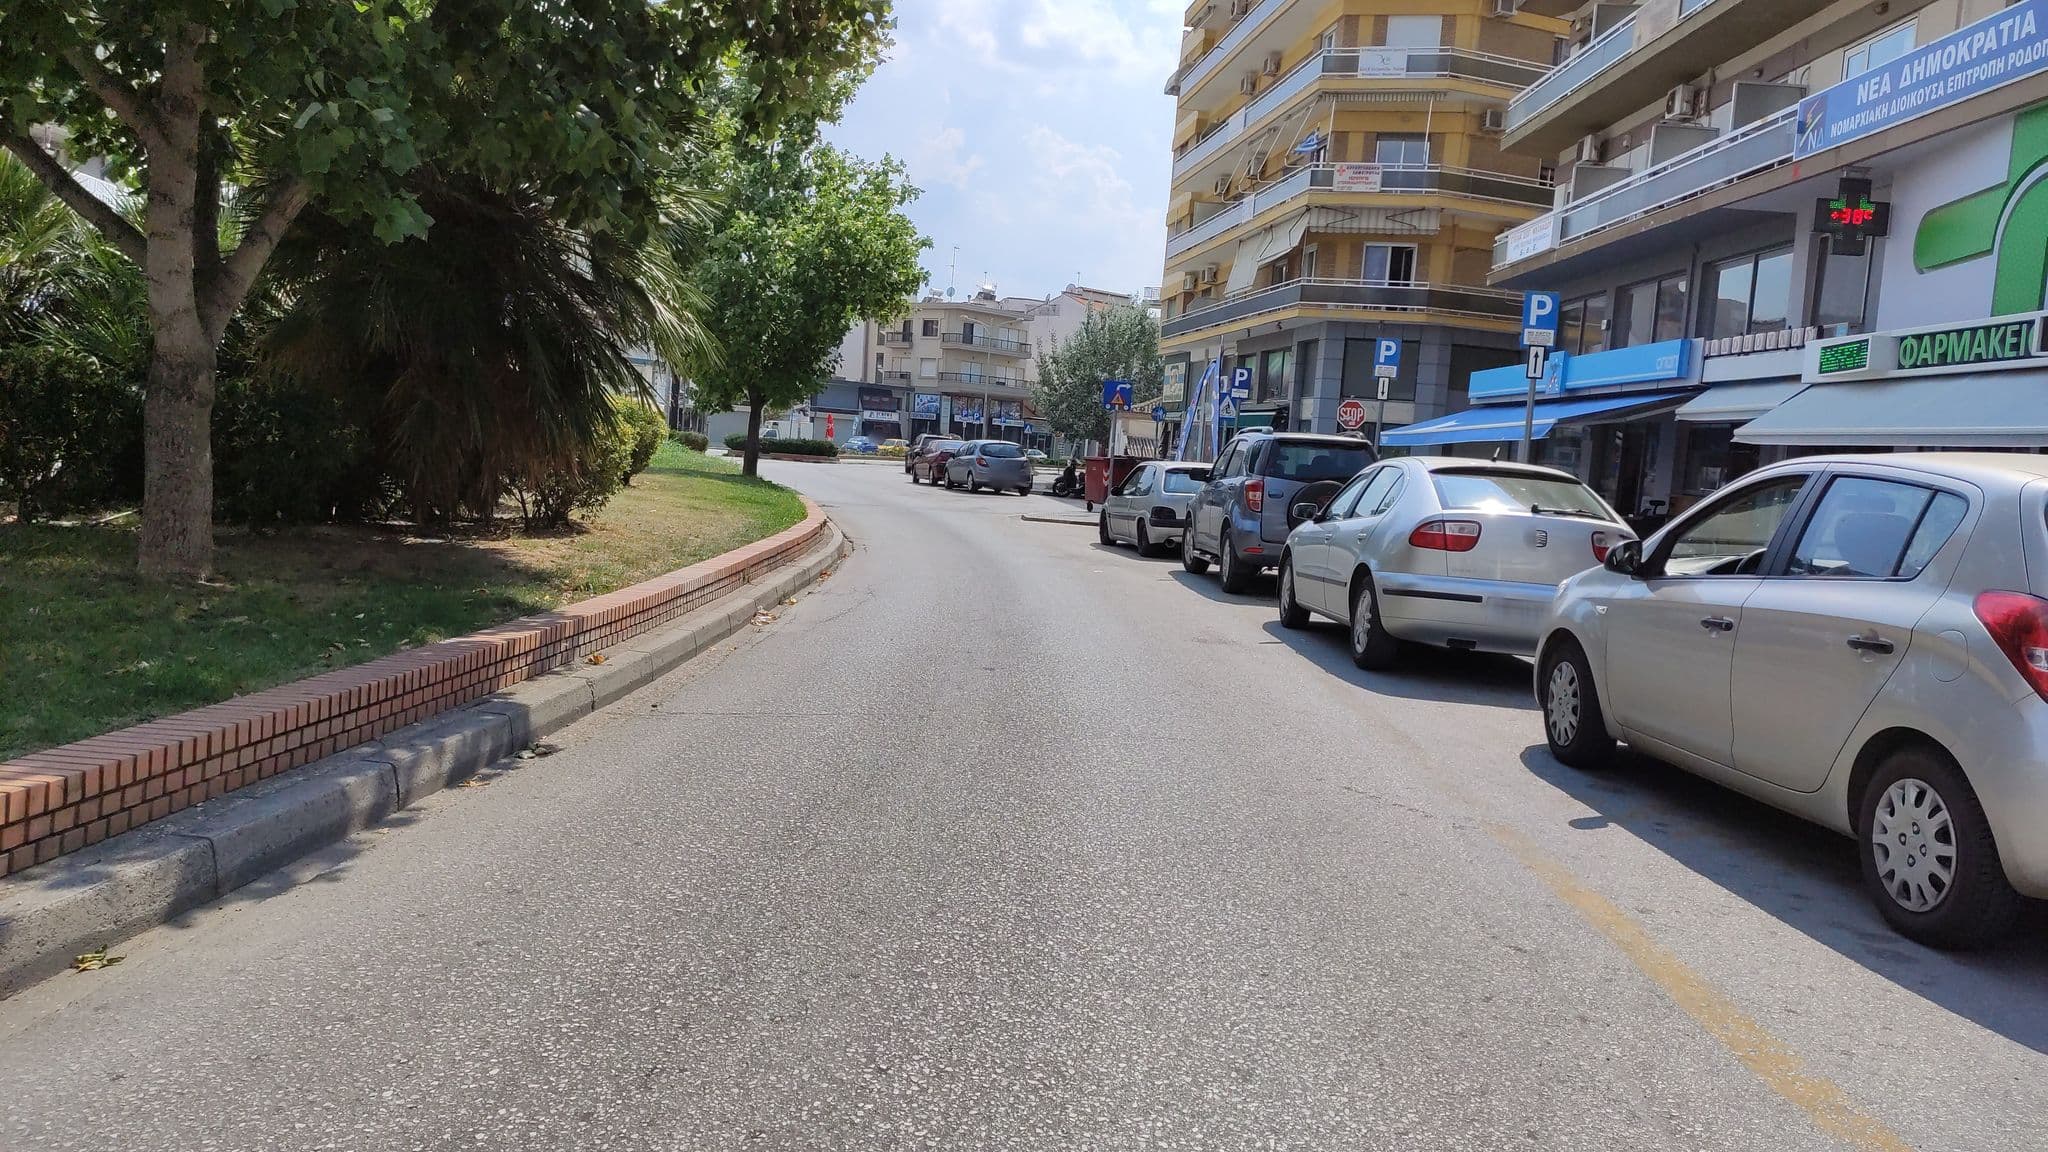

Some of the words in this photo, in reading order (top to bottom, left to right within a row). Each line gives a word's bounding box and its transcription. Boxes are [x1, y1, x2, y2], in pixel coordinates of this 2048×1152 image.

[1856, 72, 1891, 106] ΝΕΑ
[1898, 9, 2036, 89] ΔΗΜΟΚΡΑΤΙΑ
[1890, 81, 1944, 116] ΔΙΟΙΚΟΥΣΑ
[1947, 55, 2005, 94] ΕΠΙΤΡΟΠΗ
[1529, 294, 1553, 325] P
[1379, 340, 1397, 363] P
[1234, 368, 1248, 387] P
[1340, 407, 1364, 422] STOP
